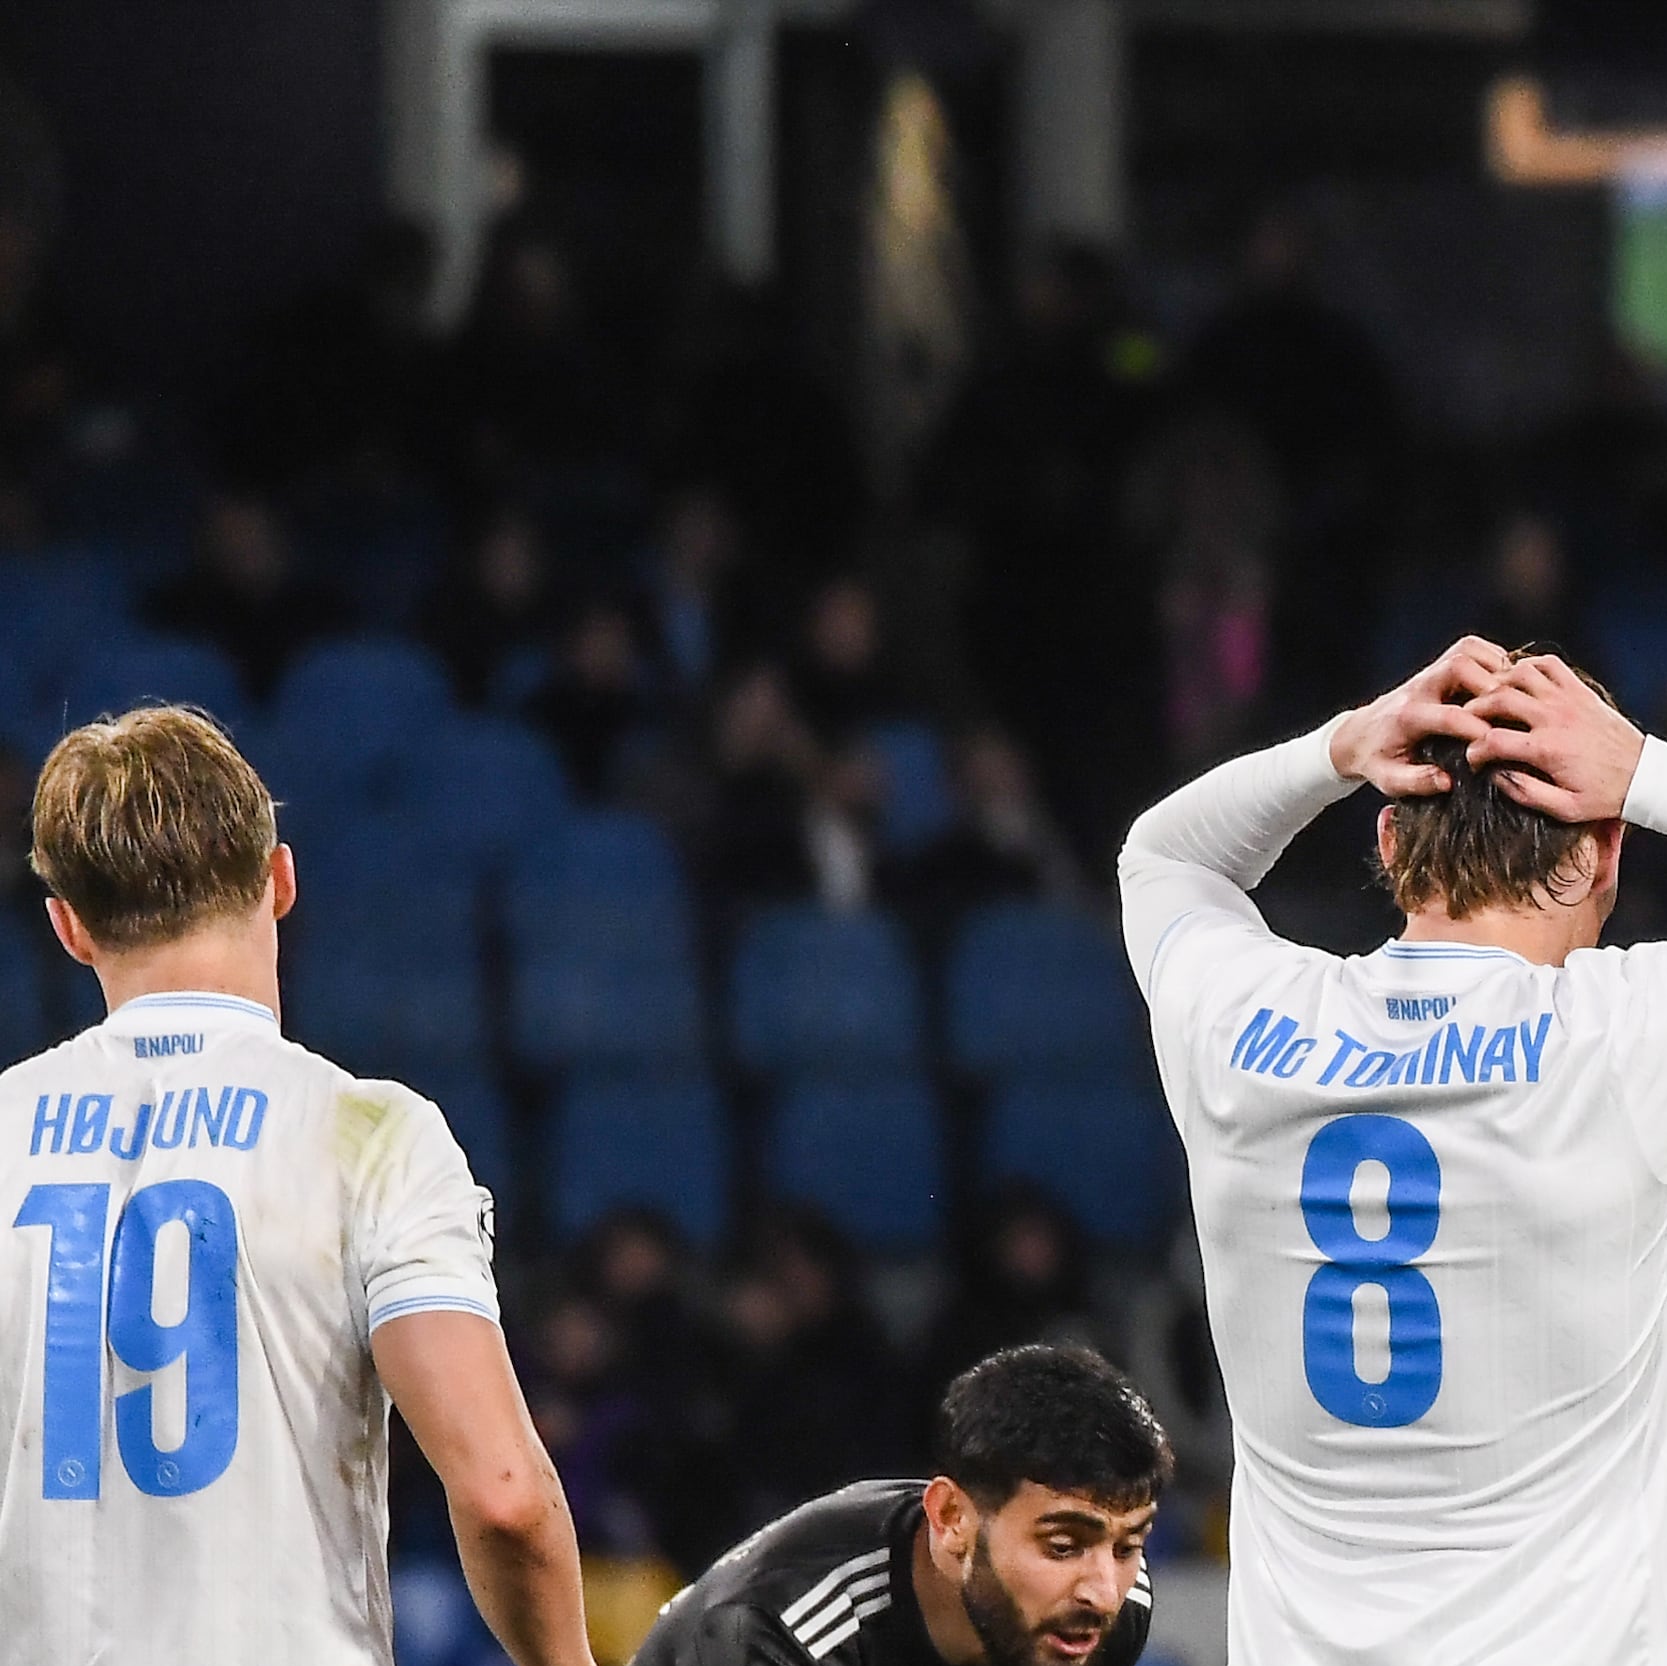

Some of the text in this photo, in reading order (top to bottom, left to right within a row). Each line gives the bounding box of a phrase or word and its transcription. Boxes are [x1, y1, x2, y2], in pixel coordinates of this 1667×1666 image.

[30, 1086, 269, 1161] HØJUND
[149, 1033, 204, 1057] NAPOLI
[12, 1179, 239, 1500] 19
[1299, 1113, 1444, 1428] 8
